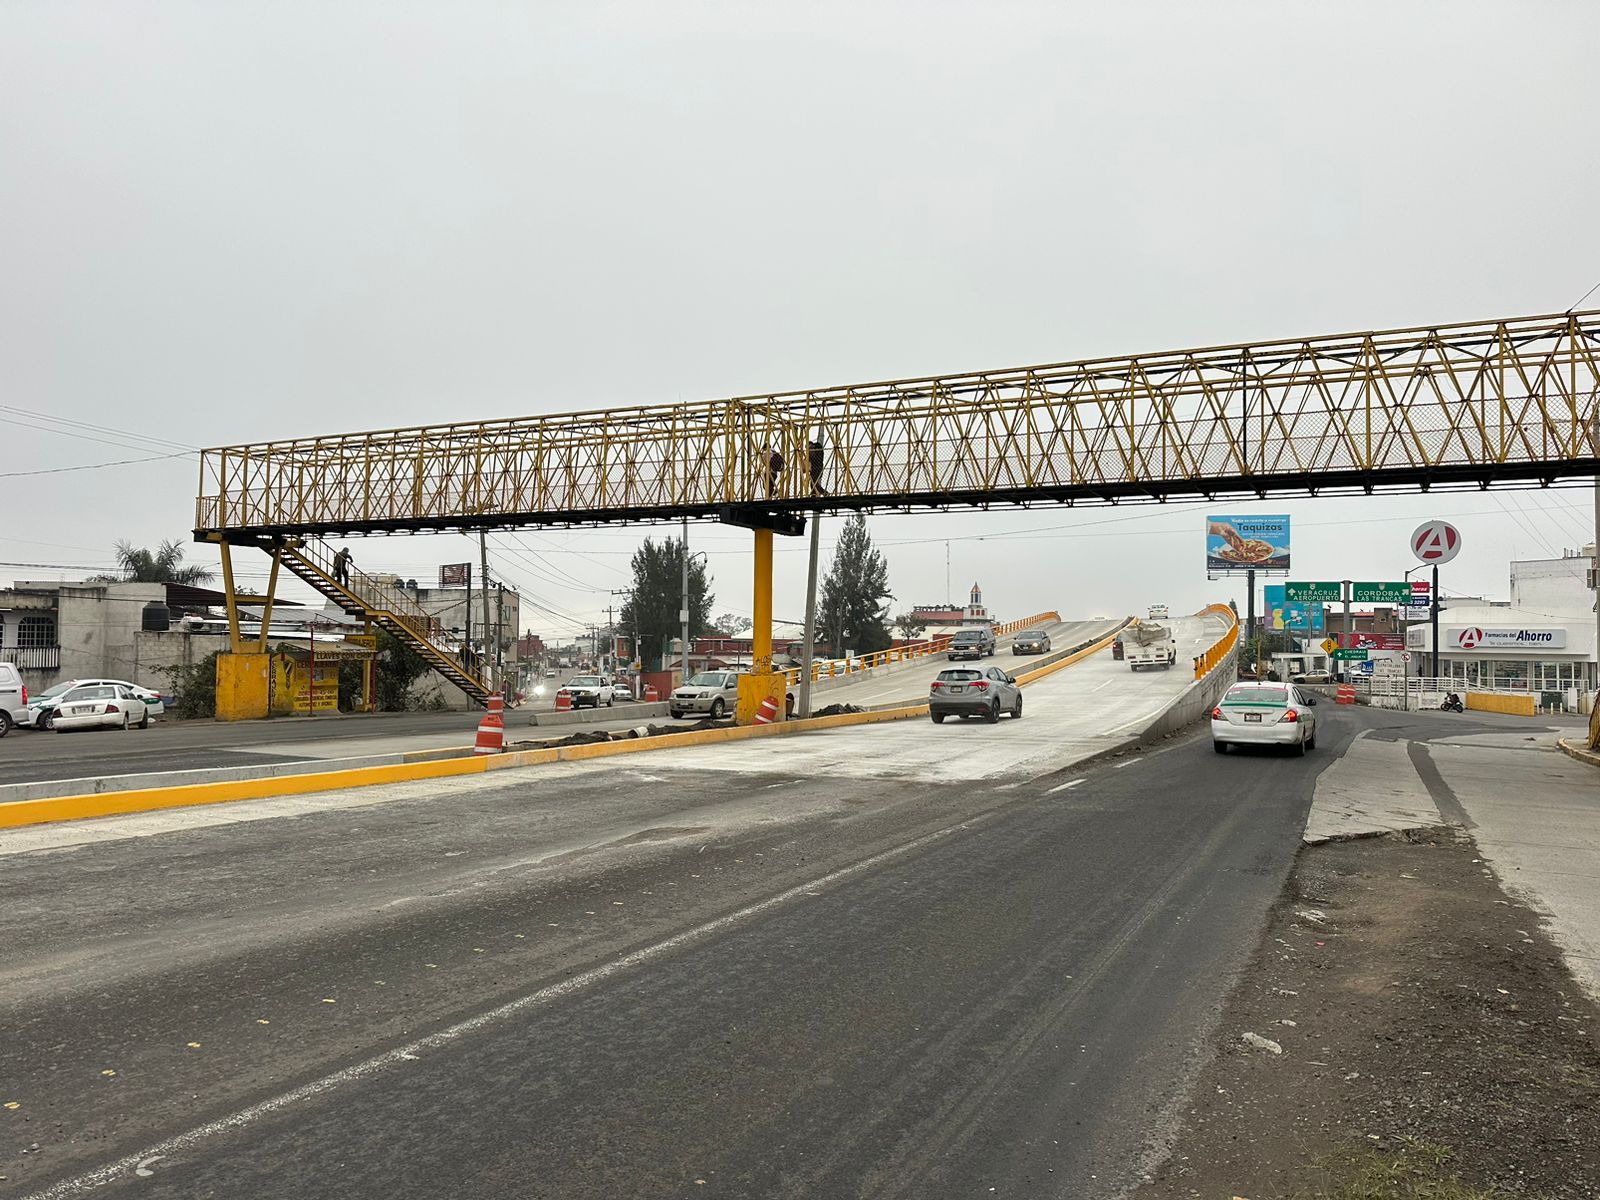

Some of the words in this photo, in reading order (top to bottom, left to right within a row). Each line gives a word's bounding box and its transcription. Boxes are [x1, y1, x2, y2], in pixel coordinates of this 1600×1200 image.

[1238, 523, 1282, 532] Taquizas
[1516, 630, 1553, 642] Ahorro
[316, 652, 341, 660] LLAVES
[341, 652, 356, 660] CON
